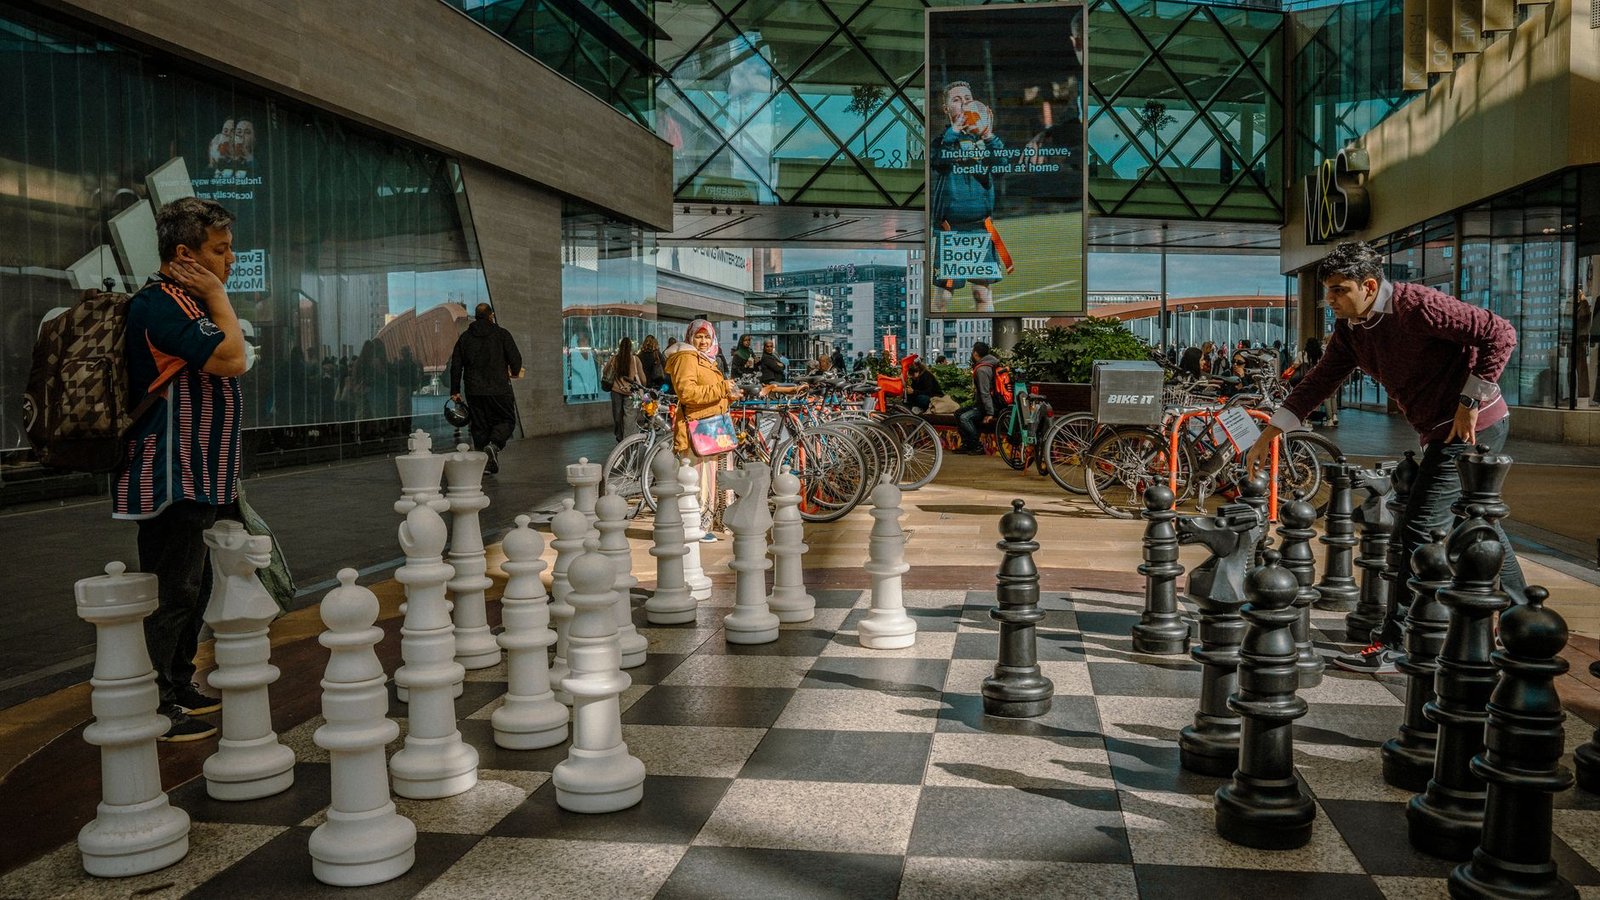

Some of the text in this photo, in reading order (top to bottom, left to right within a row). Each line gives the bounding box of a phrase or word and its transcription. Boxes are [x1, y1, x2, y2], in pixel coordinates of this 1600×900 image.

[941, 146, 1071, 159] Inclusive ways to move,
[953, 161, 1059, 175] locally and at home
[1304, 148, 1348, 244] M&S
[943, 234, 986, 248] Every
[943, 249, 981, 263] Body
[943, 263, 998, 276] Moves.
[1108, 394, 1155, 405] BIKE IT
